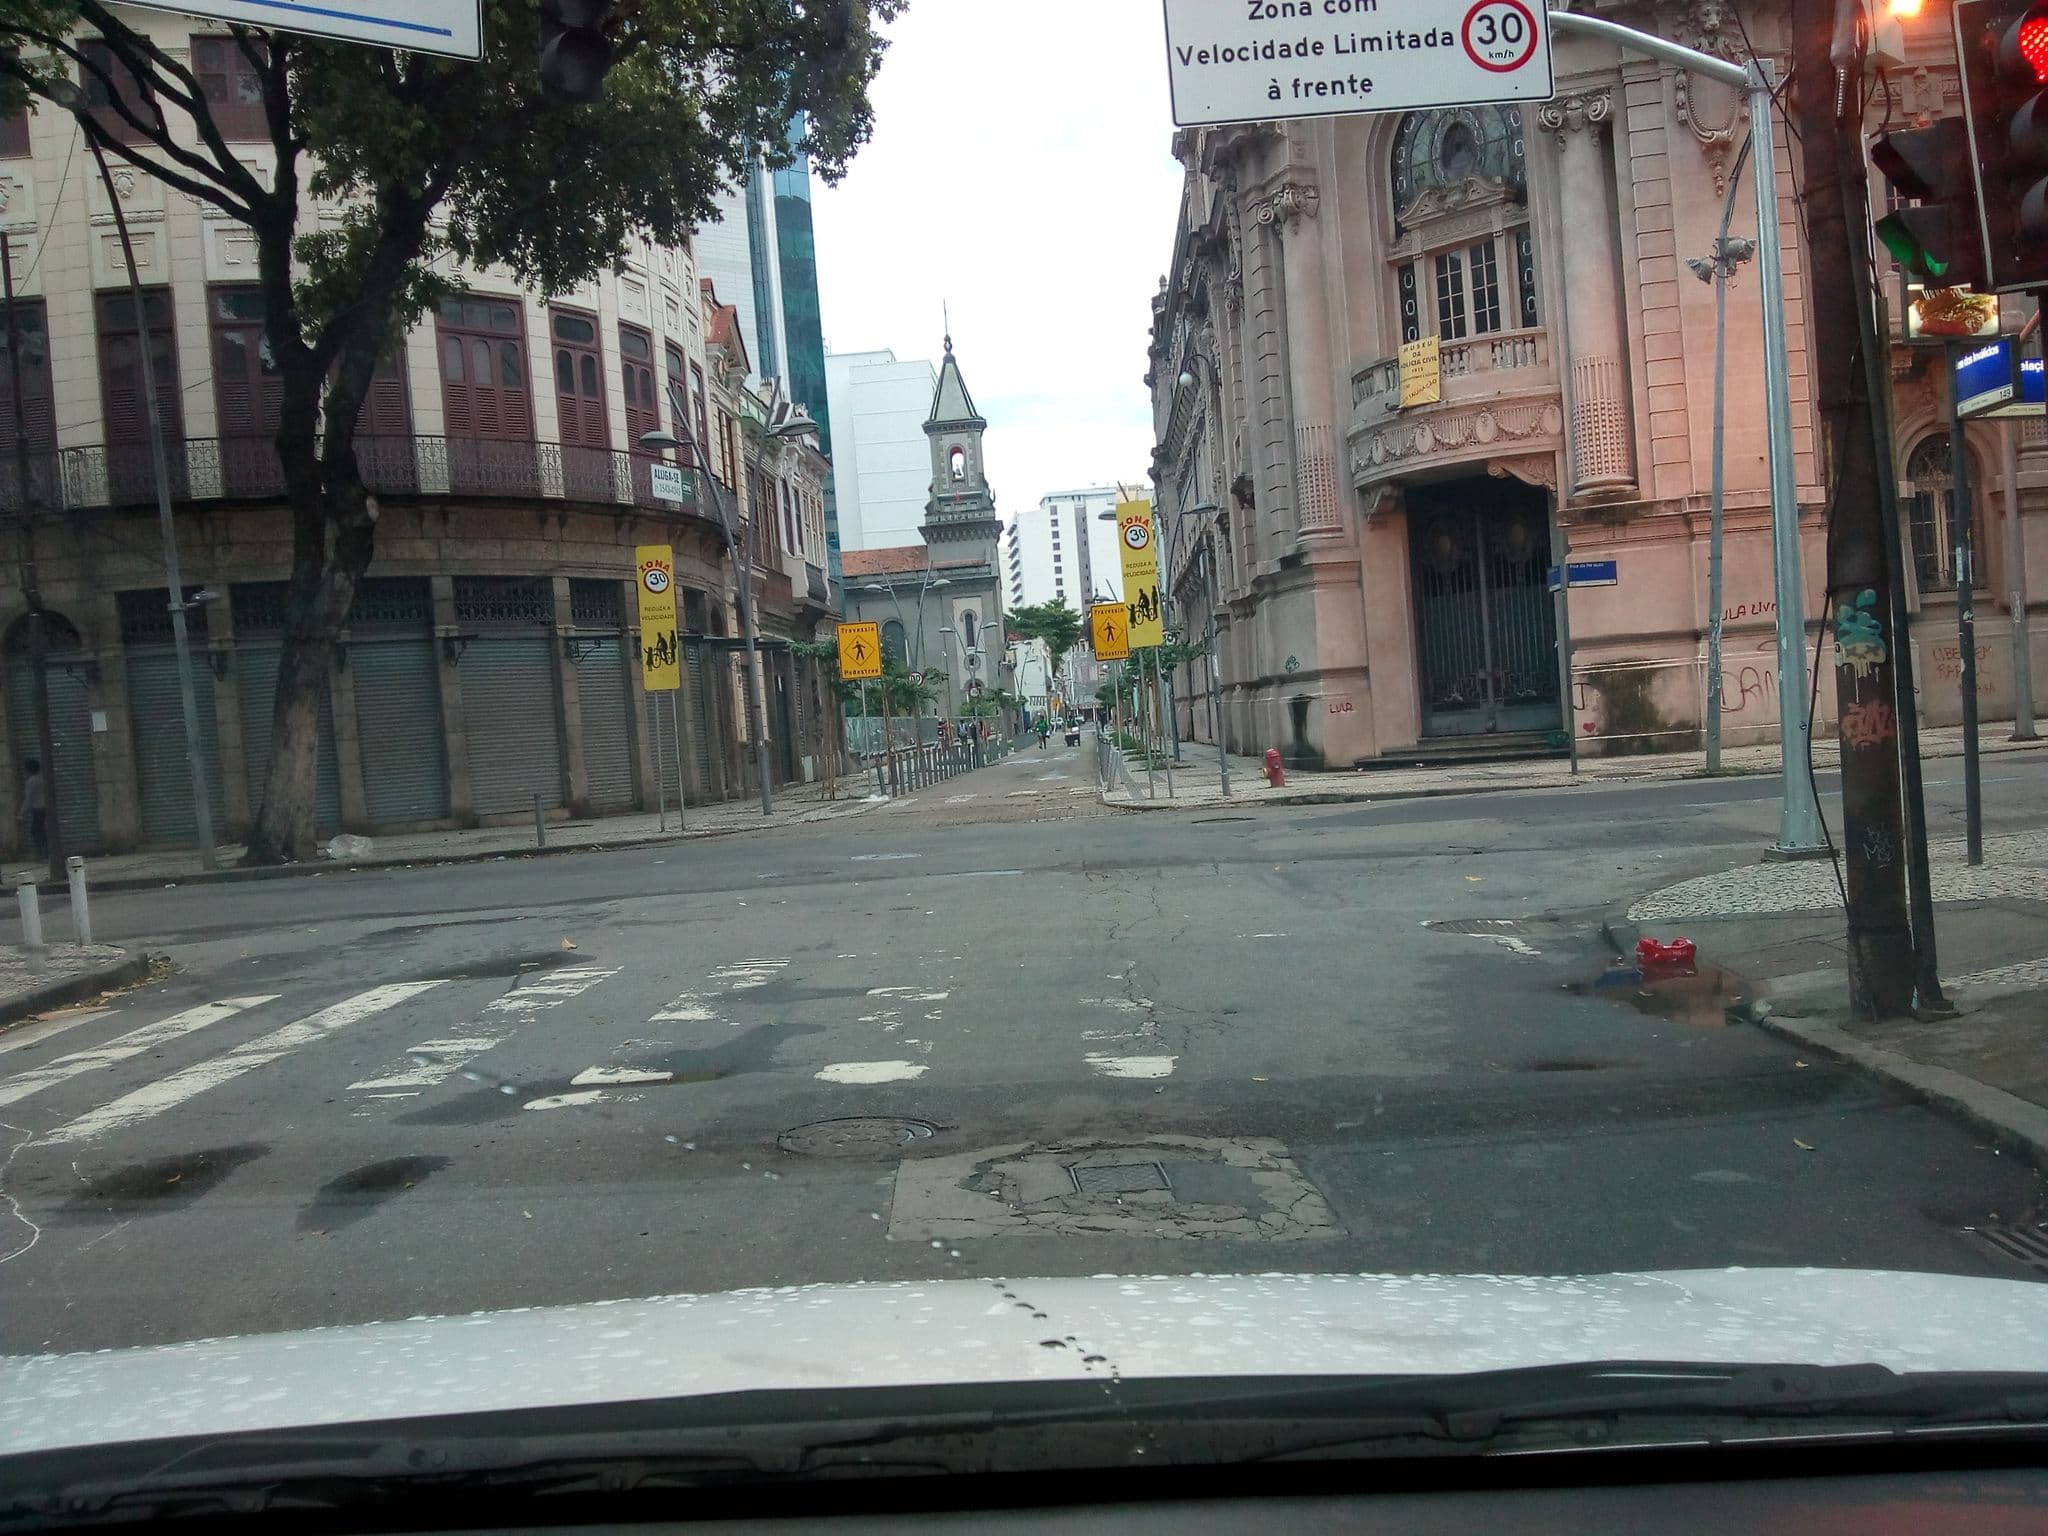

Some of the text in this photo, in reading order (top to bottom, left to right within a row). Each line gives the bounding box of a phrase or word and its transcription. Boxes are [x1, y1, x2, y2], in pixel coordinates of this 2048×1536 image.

[1247, 0, 1379, 21] Zona com
[1476, 12, 1524, 46] 30
[1175, 25, 1455, 67] Velocidade Limitada
[1487, 49, 1515, 60] km/h
[1266, 75, 1375, 101] à frente
[654, 468, 679, 484] ALUGA-SE
[1119, 515, 1151, 530] ZONA
[1129, 528, 1147, 542] 30
[639, 559, 671, 573] ZONA
[649, 573, 667, 586] 30
[840, 626, 875, 634] Travessia
[843, 668, 879, 676] Pedestres
